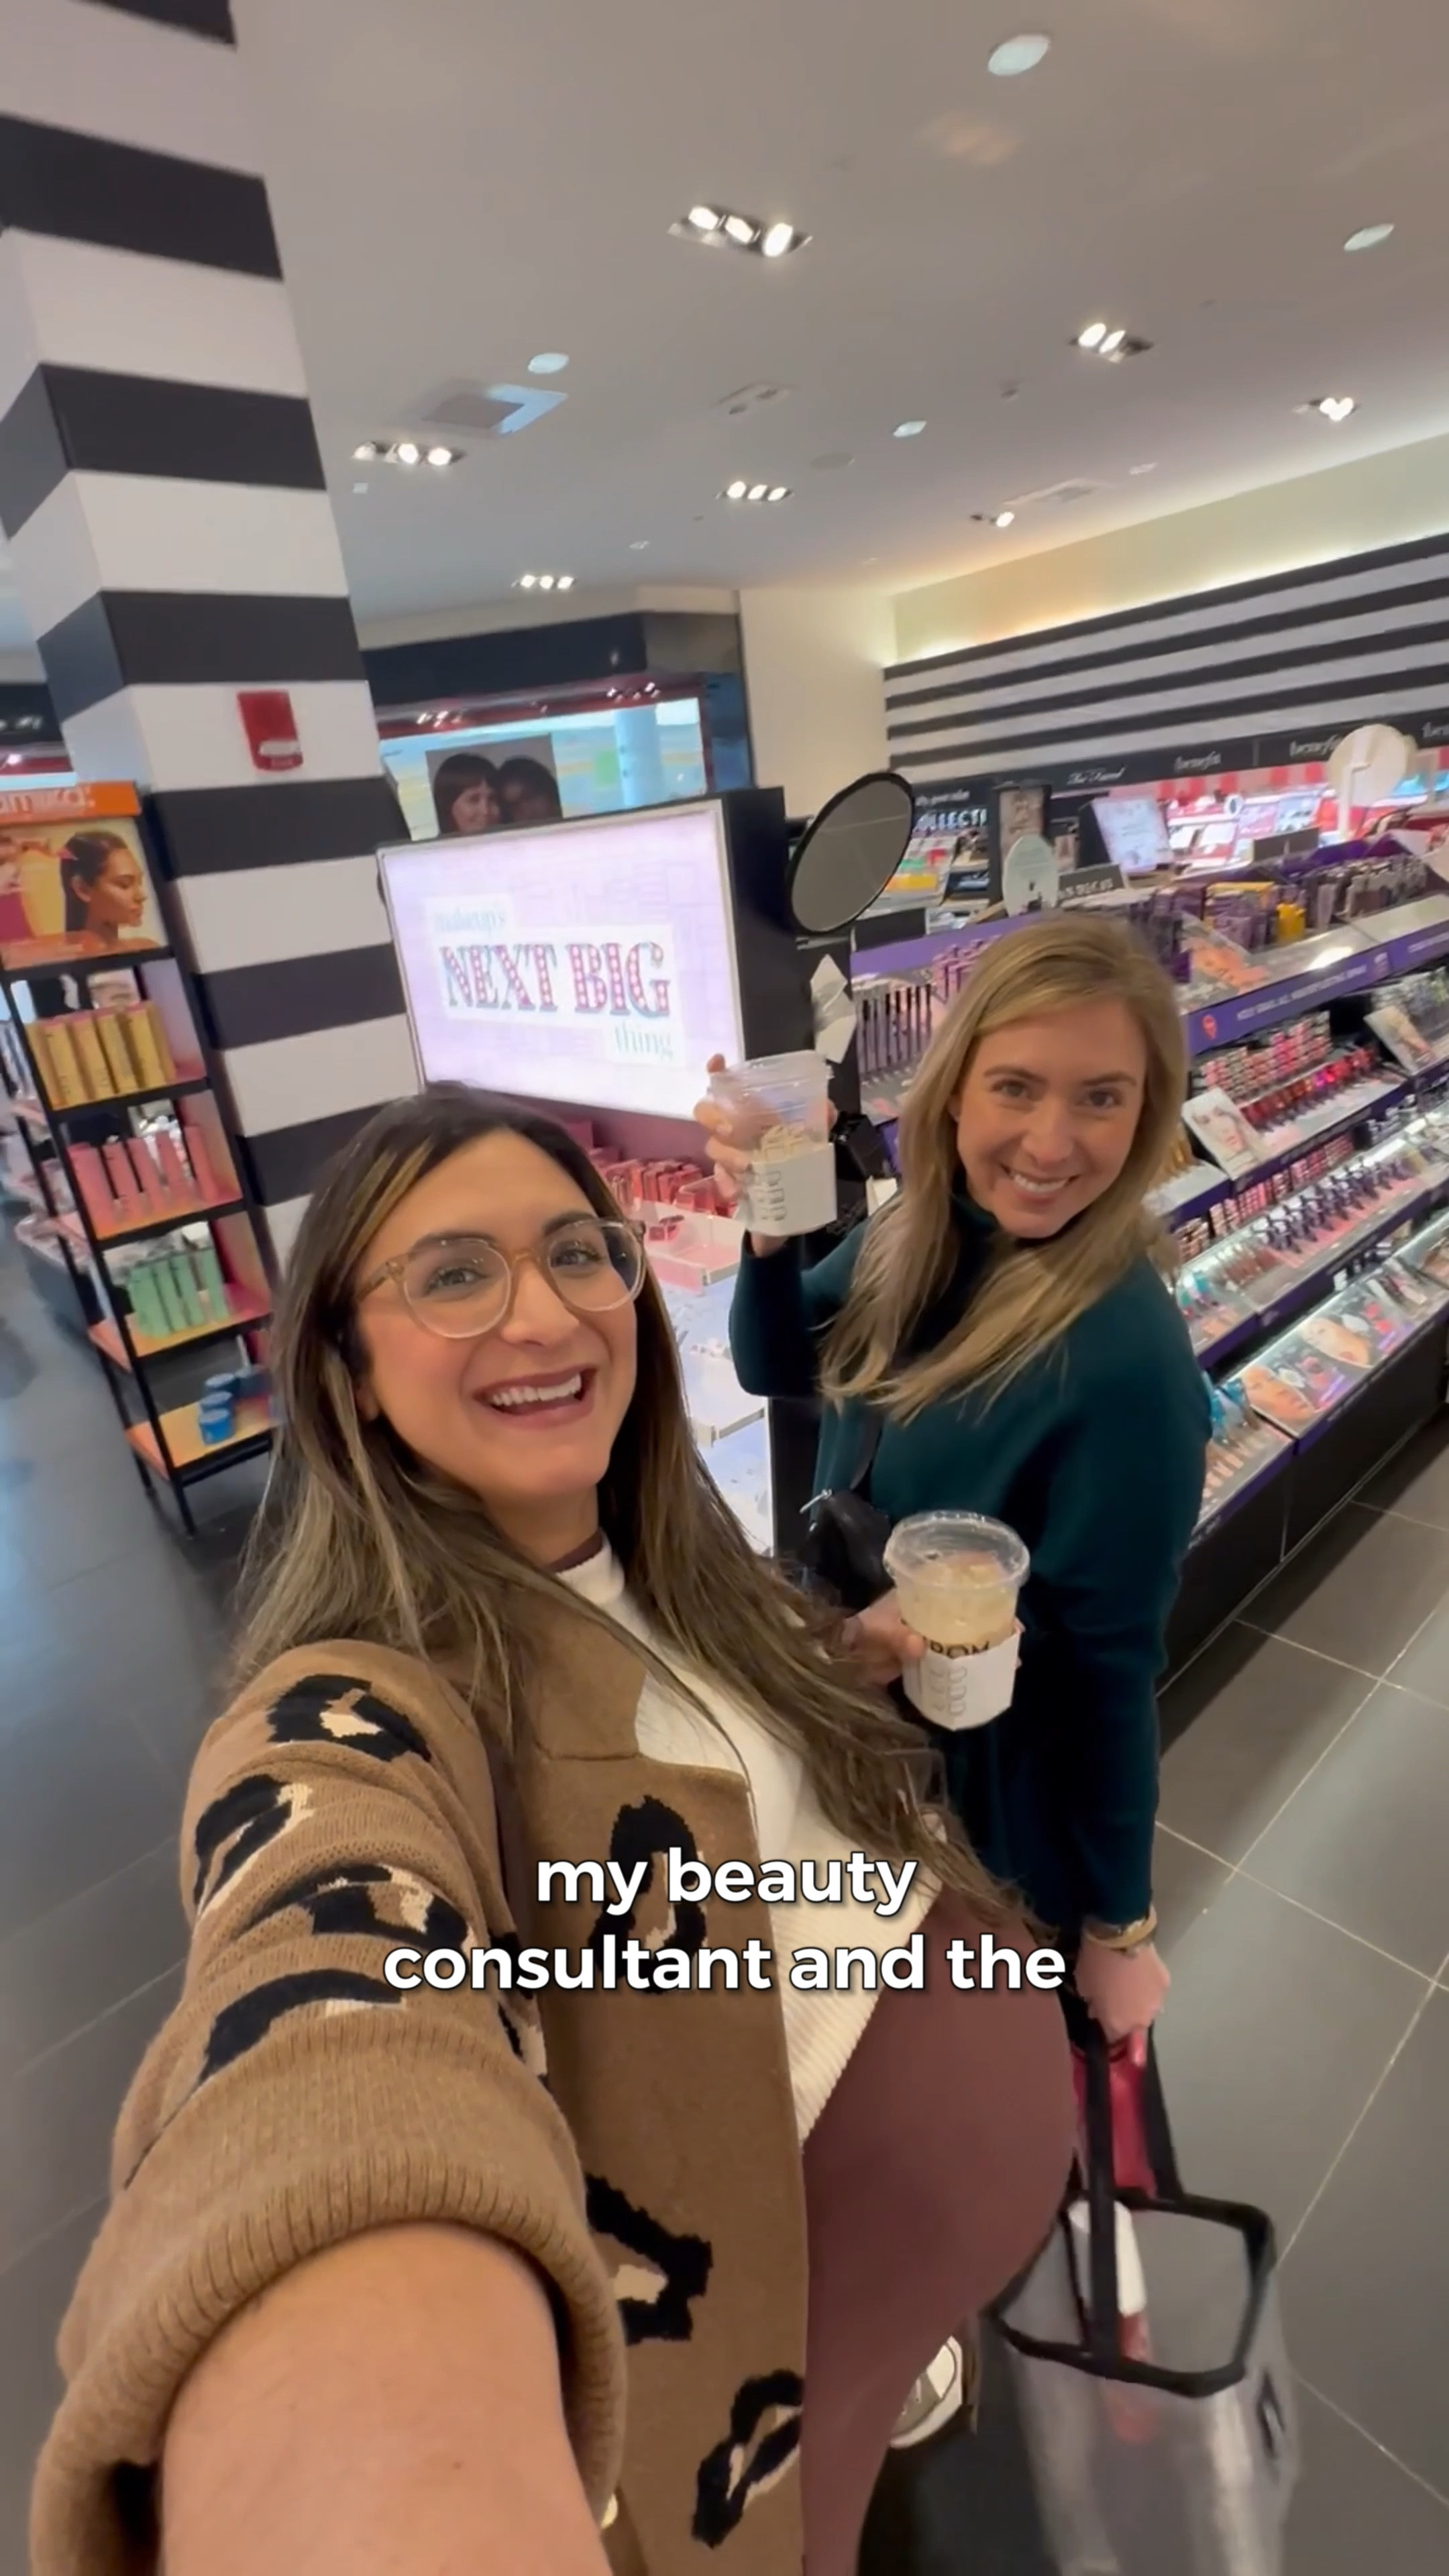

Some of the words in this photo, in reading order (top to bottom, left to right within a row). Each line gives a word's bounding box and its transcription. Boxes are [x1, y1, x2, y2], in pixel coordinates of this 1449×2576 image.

[439, 943, 558, 1013] NEXT
[565, 941, 671, 1018] BIG
[614, 1022, 674, 1060] thing
